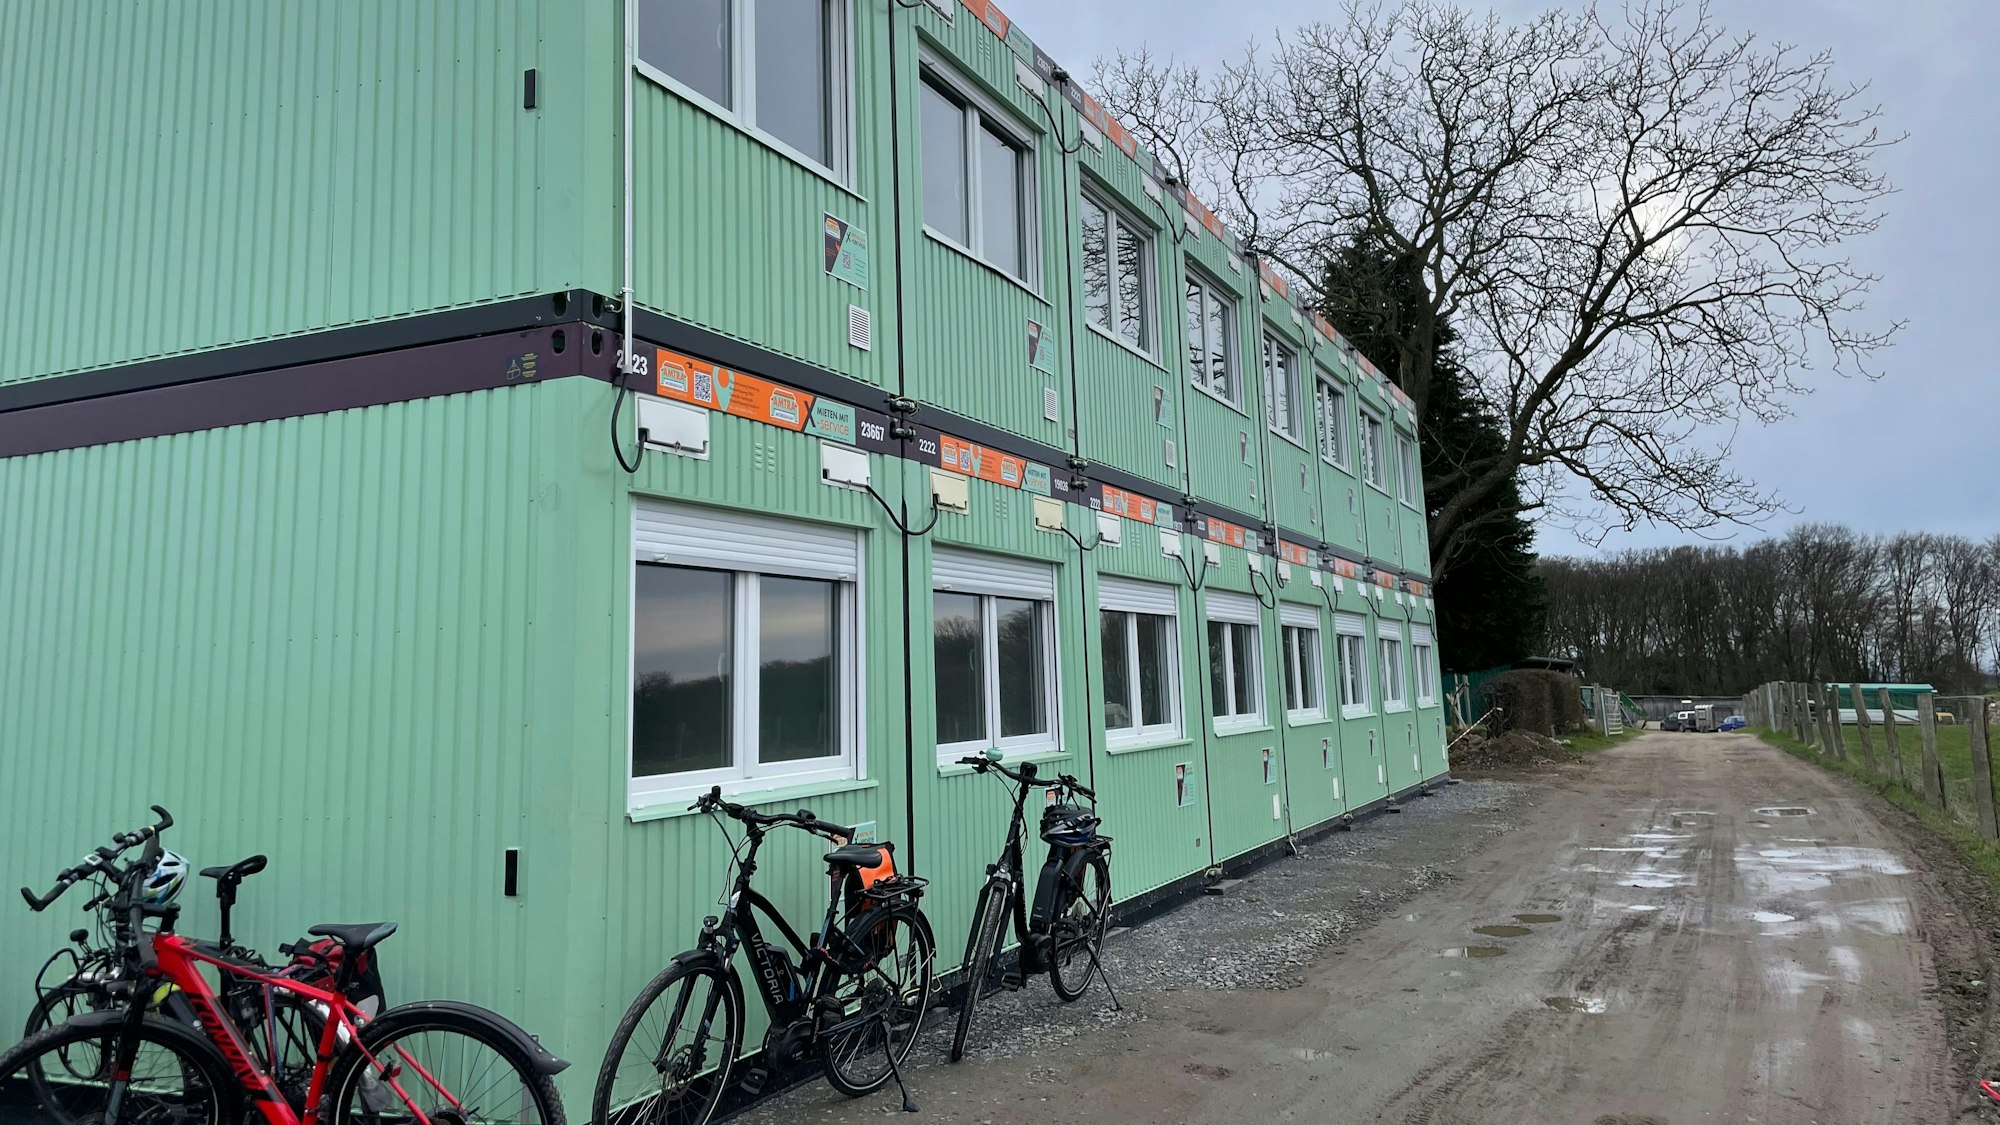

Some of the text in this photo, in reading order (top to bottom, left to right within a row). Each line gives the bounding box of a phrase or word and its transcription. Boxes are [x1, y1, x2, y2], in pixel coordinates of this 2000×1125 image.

[616, 349, 648, 376] 223
[772, 396, 797, 412] AMTRA
[816, 407, 849, 423] MIETEN MIT
[860, 421, 885, 442] 23667
[918, 438, 937, 455] 2222
[751, 932, 784, 1005] VICTORIA
